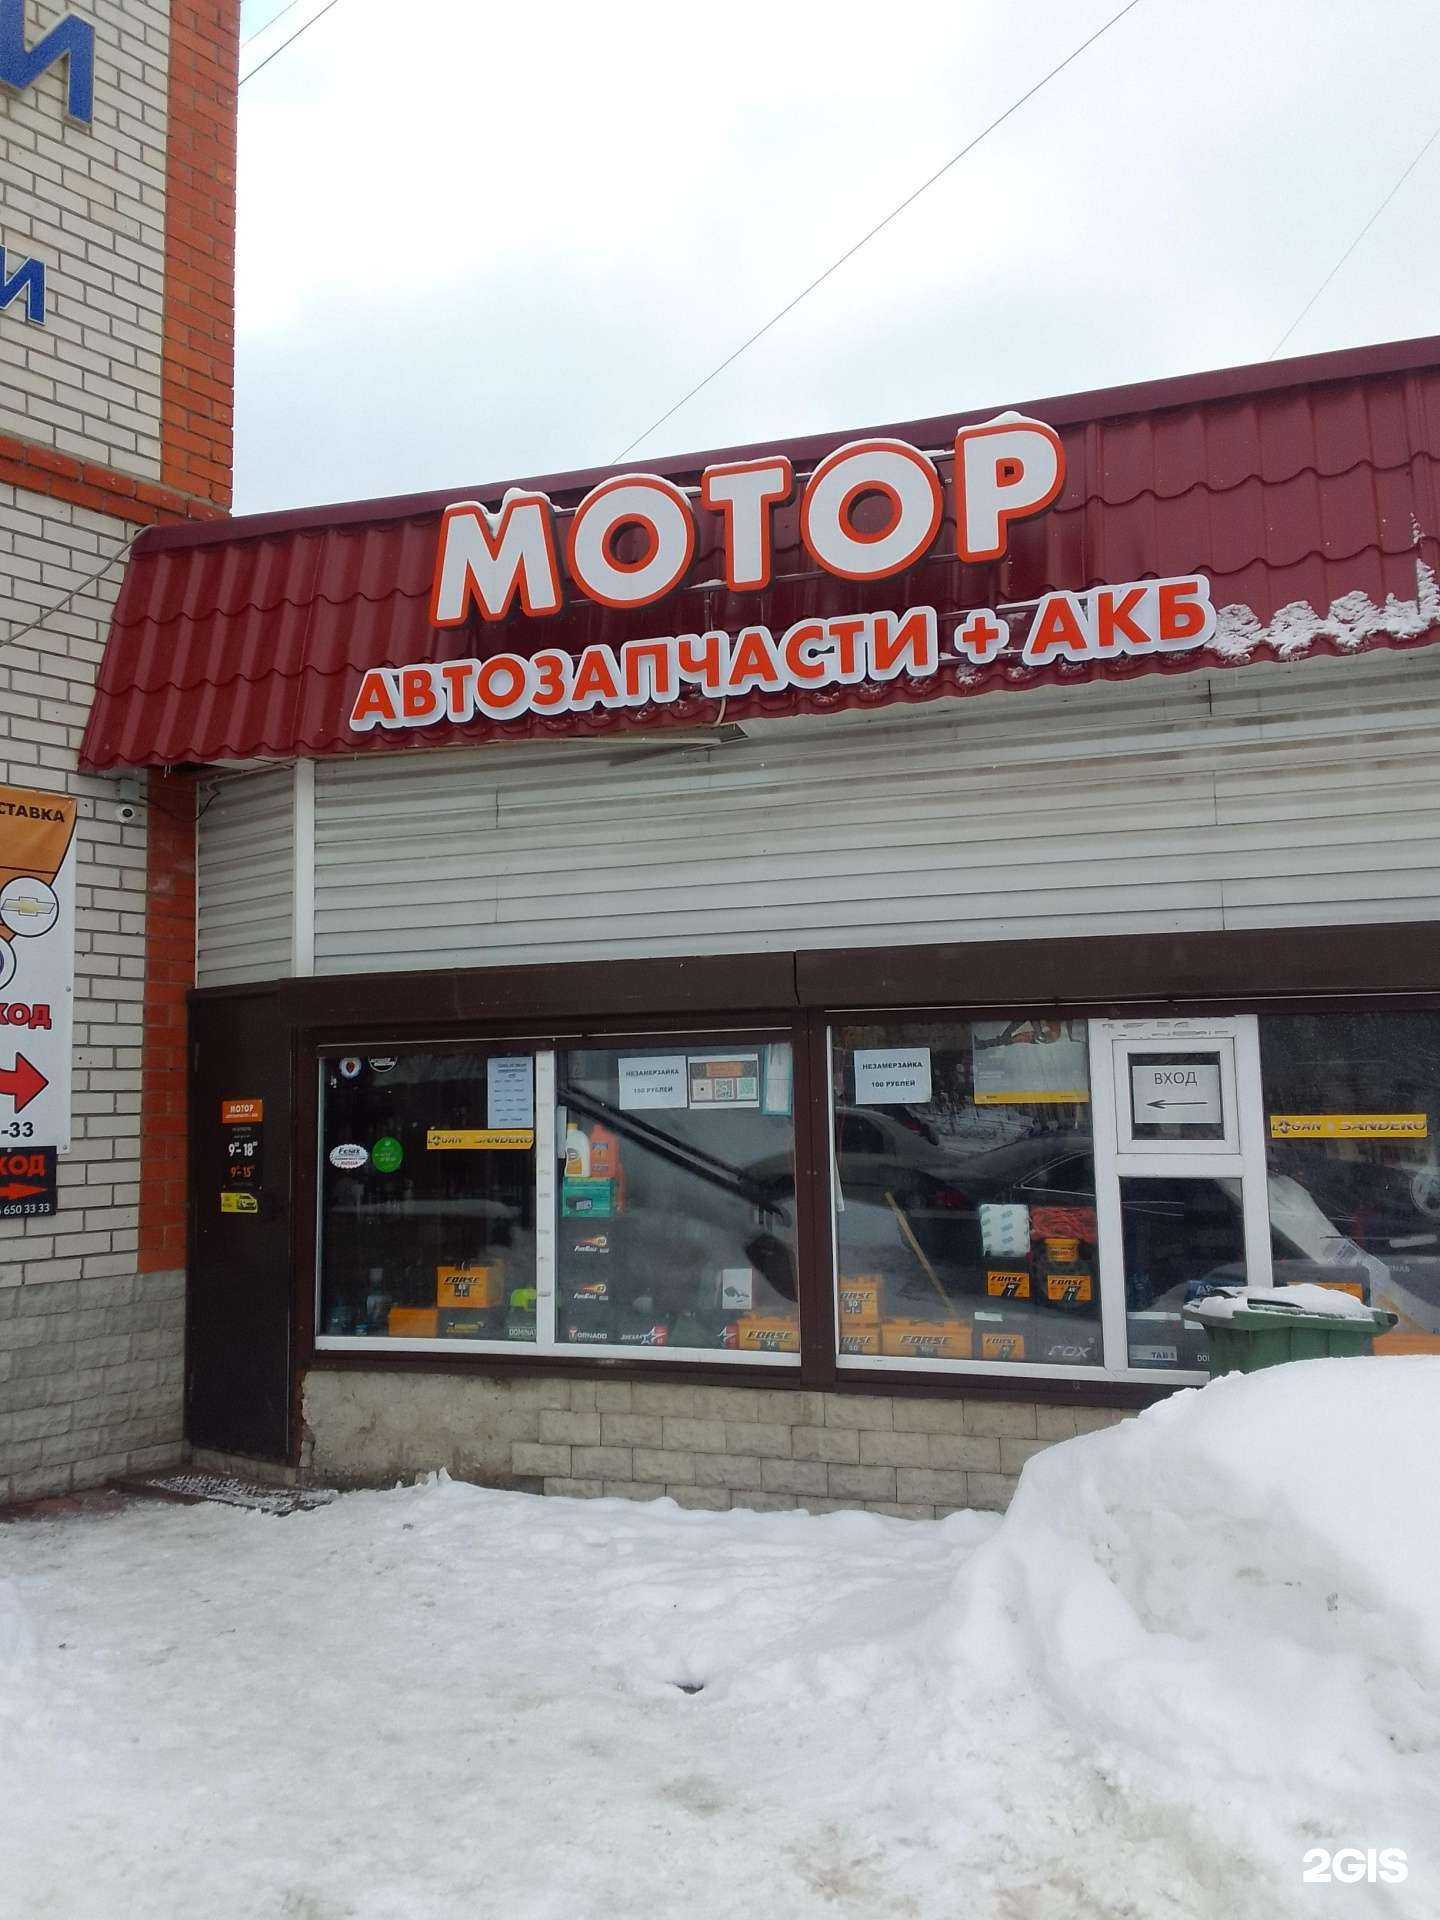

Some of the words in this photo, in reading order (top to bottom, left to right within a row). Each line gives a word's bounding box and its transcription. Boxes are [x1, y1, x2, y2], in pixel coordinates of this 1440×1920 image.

[430, 418, 1066, 628] МОТОР
[349, 607, 937, 730] АВТОЗАПЧАСТИ
[1024, 576, 1214, 664] АКБ
[1154, 1071, 1198, 1087] ВХОД
[1340, 1120, 1426, 1131] SANDERO
[3, 1204, 22, 1215] 650
[24, 1203, 36, 1214] 33
[38, 1203, 50, 1213] 33
